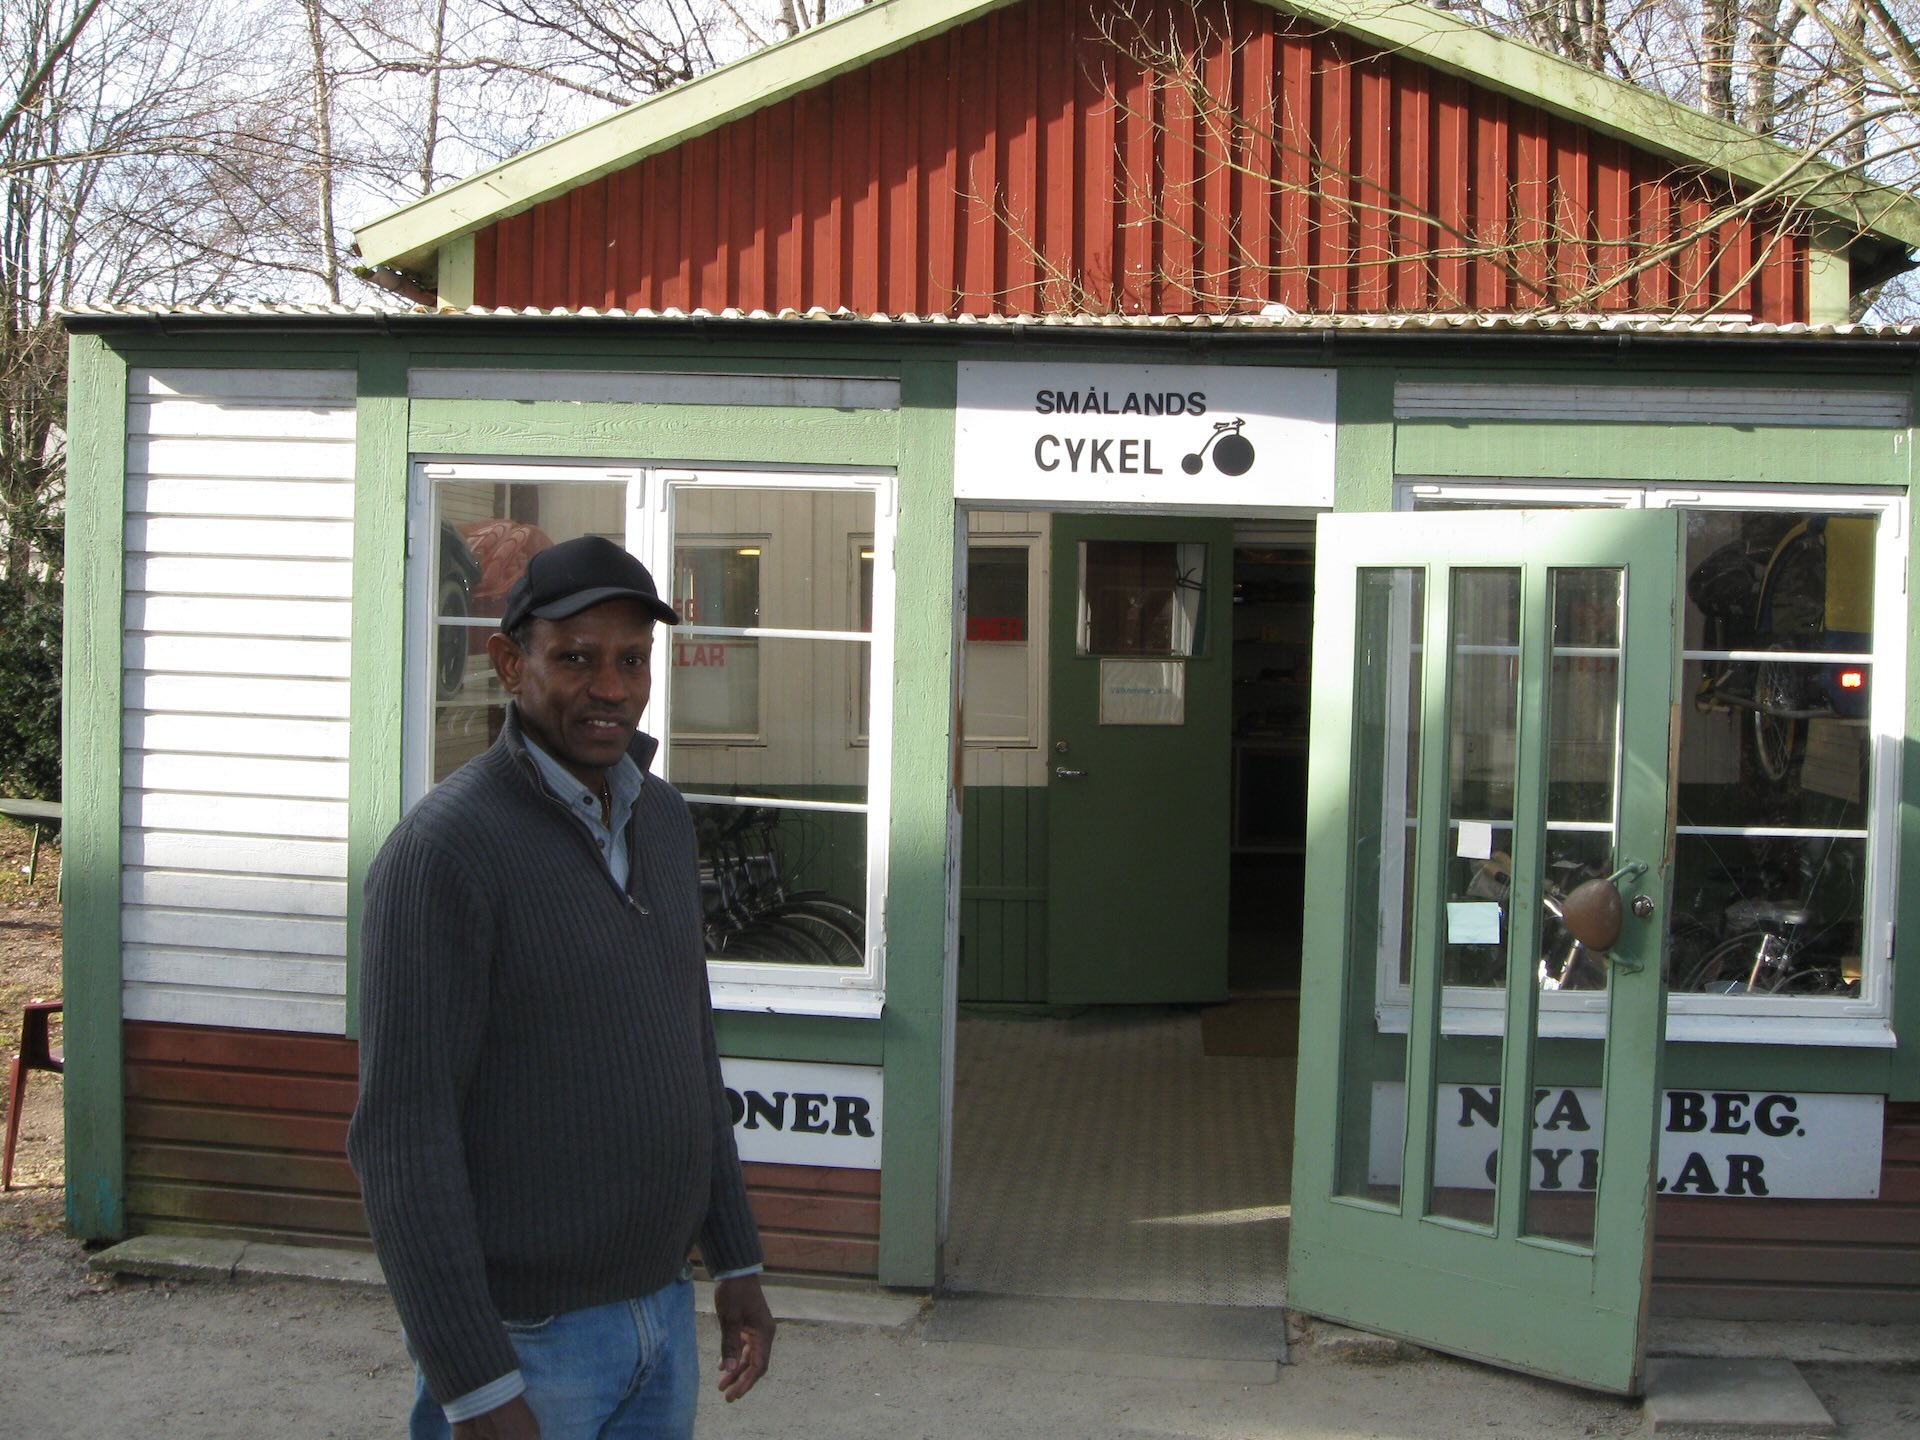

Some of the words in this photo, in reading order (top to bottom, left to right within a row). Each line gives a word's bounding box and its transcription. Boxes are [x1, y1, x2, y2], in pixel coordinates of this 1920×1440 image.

[1034, 386, 1207, 417] SMÅLANDS
[1034, 434, 1164, 475] CYKEL
[1665, 1091, 1806, 1138] BEG.
